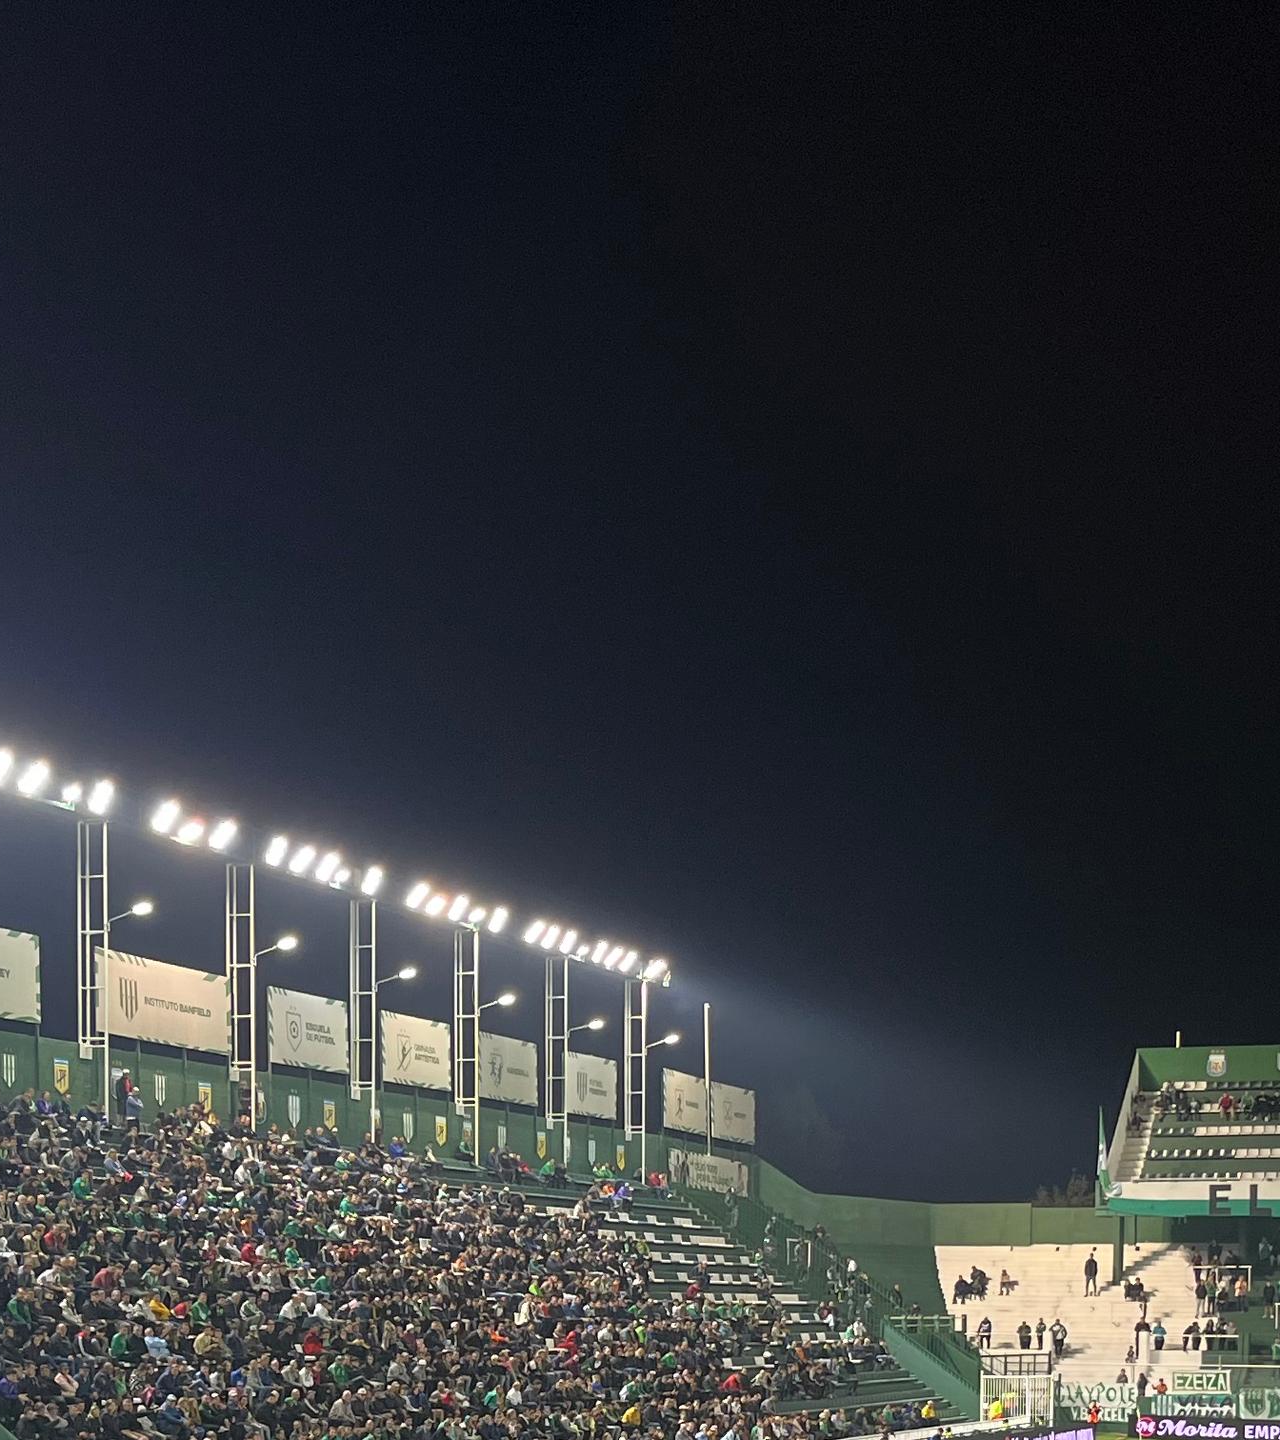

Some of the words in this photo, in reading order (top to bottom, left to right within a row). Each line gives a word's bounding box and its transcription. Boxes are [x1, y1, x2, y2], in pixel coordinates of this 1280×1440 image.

[1208, 1183, 1273, 1217] EL
[1174, 1373, 1228, 1391] EZEIZA
[1157, 1418, 1238, 1439] Morita
